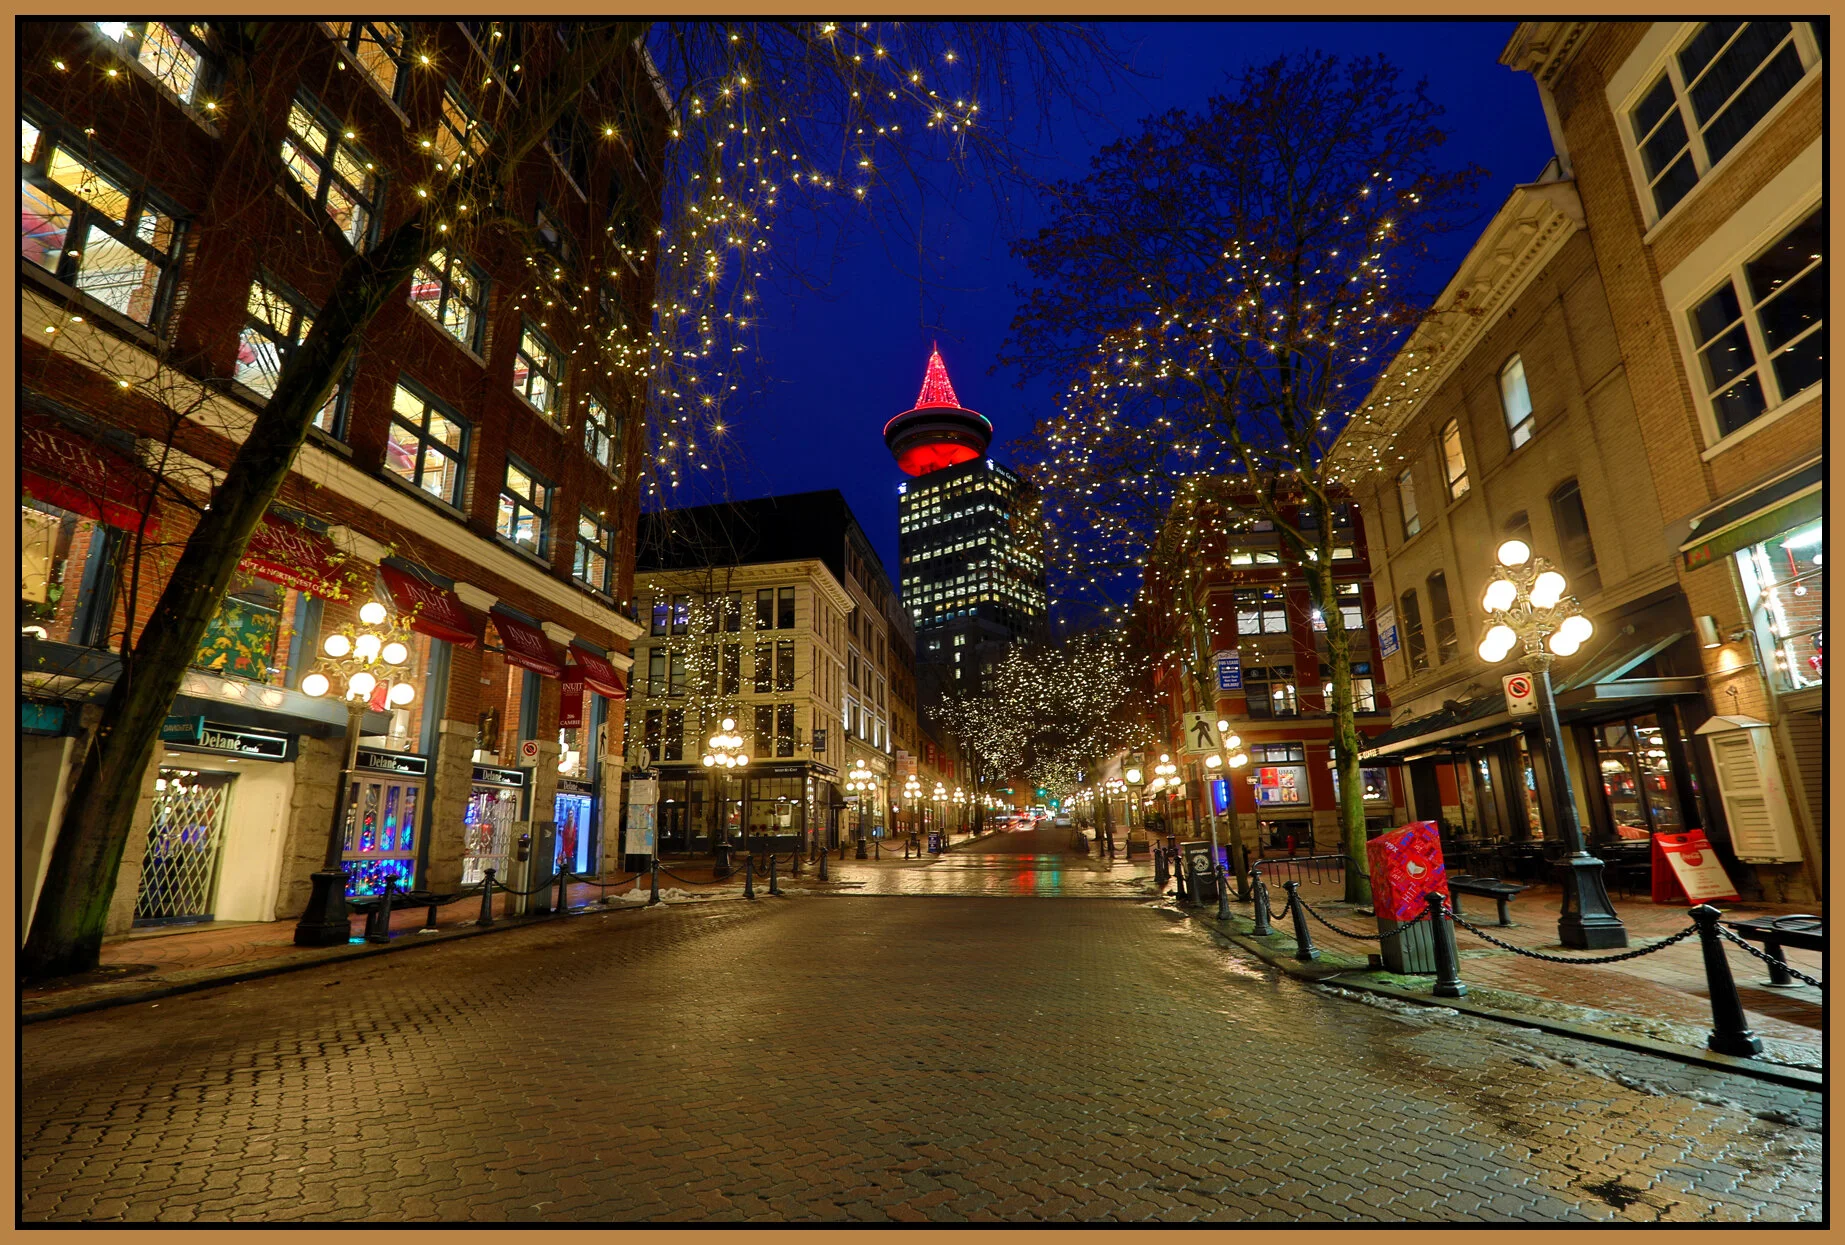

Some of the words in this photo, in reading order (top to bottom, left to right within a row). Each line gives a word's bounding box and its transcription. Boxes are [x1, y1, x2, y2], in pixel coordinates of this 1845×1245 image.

[562, 682, 583, 690] INUIT
[199, 730, 242, 751] Delané
[369, 754, 397, 770] Delané
